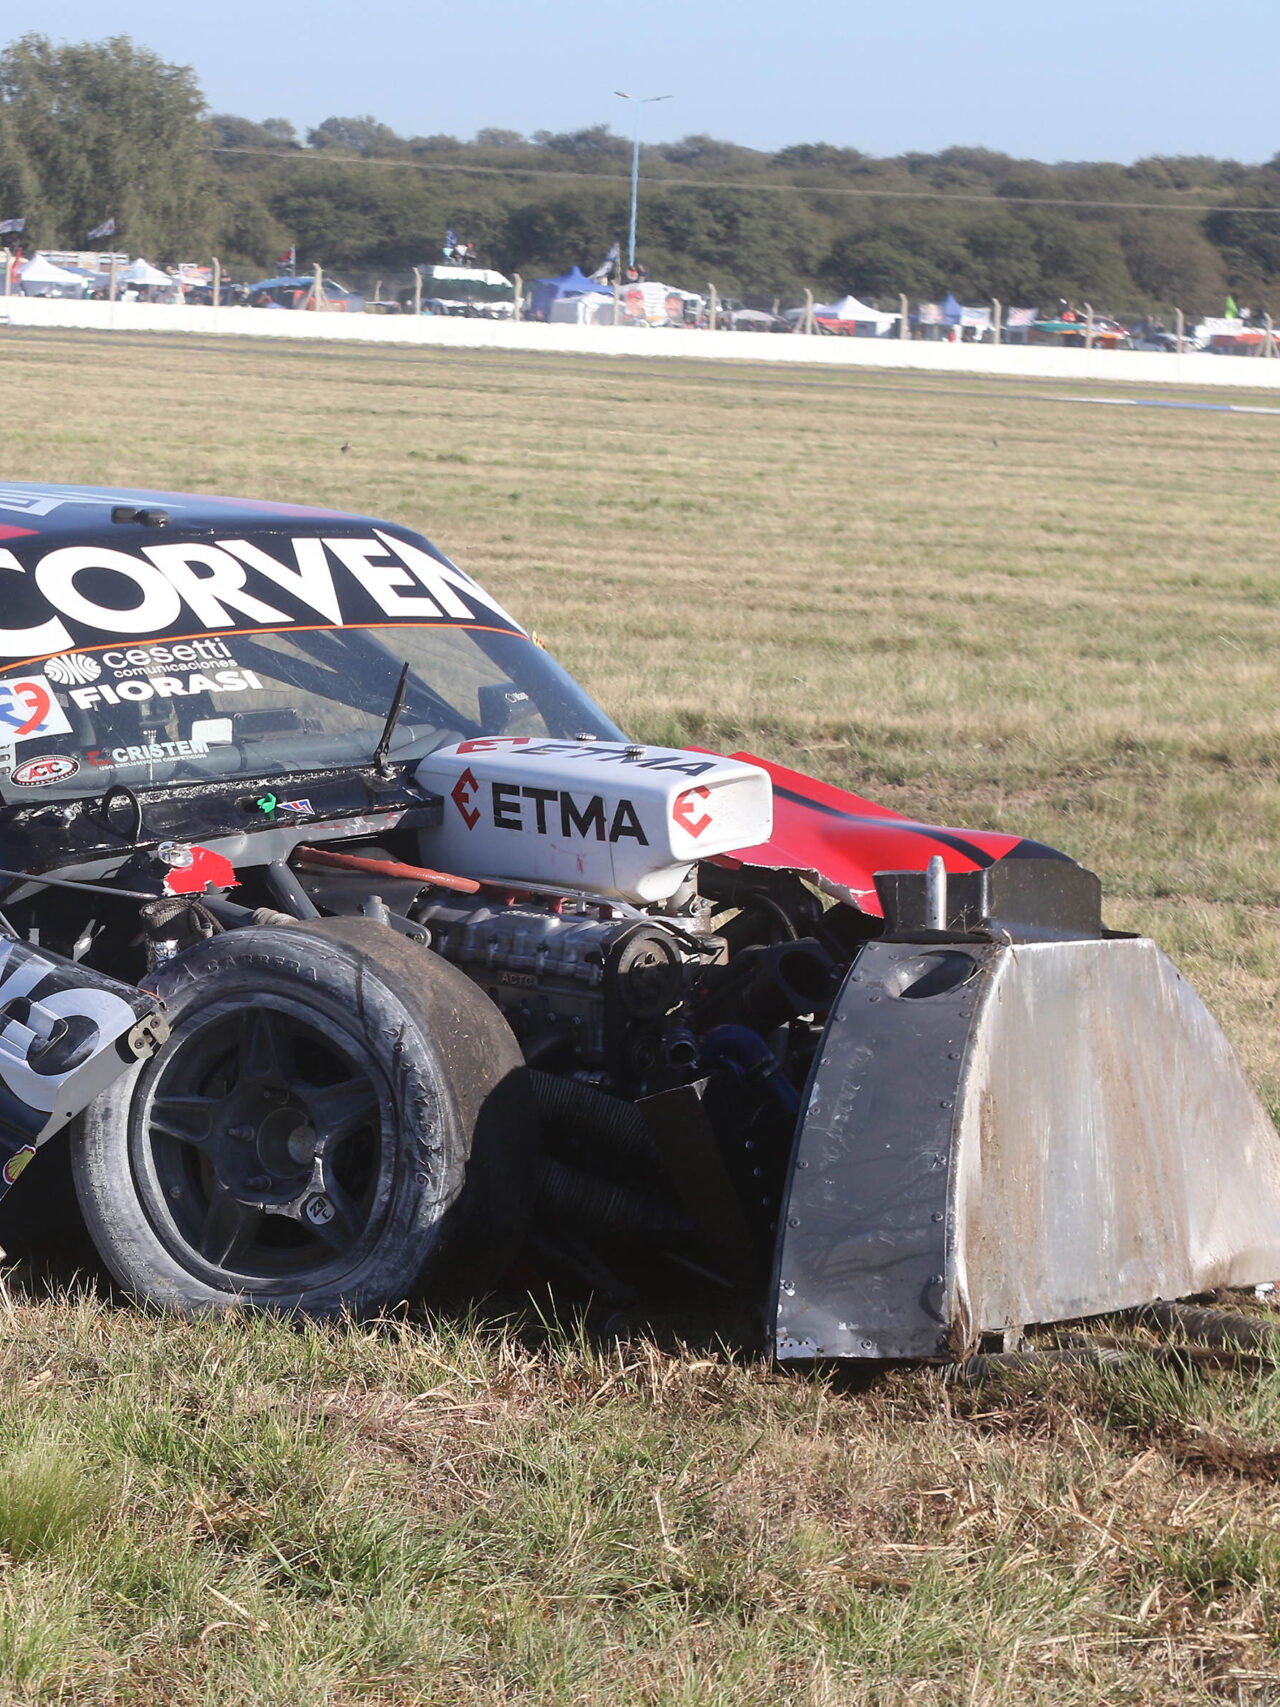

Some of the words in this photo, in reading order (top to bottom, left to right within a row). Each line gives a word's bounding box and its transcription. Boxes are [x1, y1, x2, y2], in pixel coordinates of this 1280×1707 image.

[102, 637, 233, 669] cesetti
[113, 658, 239, 678] comunicaciones
[68, 670, 264, 710] FIORASI
[112, 739, 210, 763] CRISTEM
[510, 743, 718, 777] ETMA
[491, 782, 650, 846] ETMA
